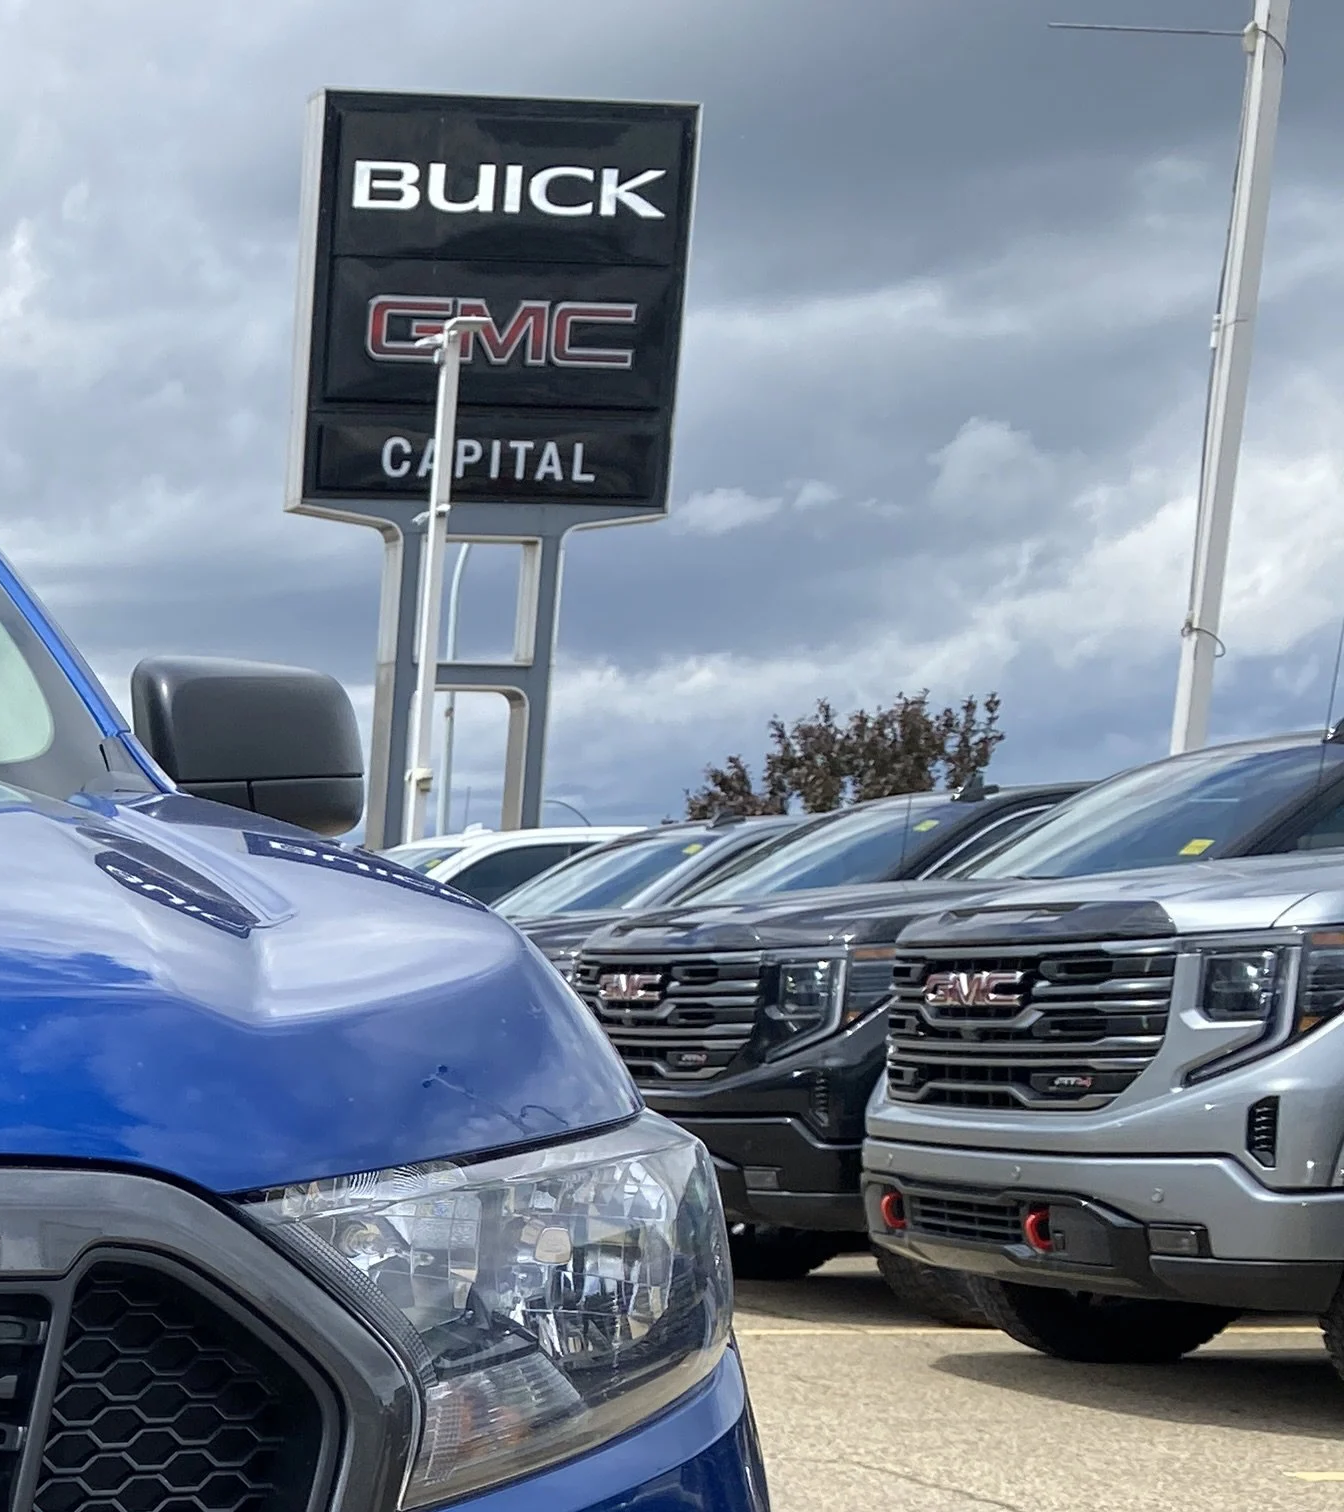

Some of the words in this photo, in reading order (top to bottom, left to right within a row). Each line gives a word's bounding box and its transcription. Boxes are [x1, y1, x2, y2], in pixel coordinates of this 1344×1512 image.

[352, 160, 666, 219] BUICK
[367, 295, 638, 370] GMC
[381, 436, 596, 482] CAPITAL
[923, 971, 1024, 1006] GMC
